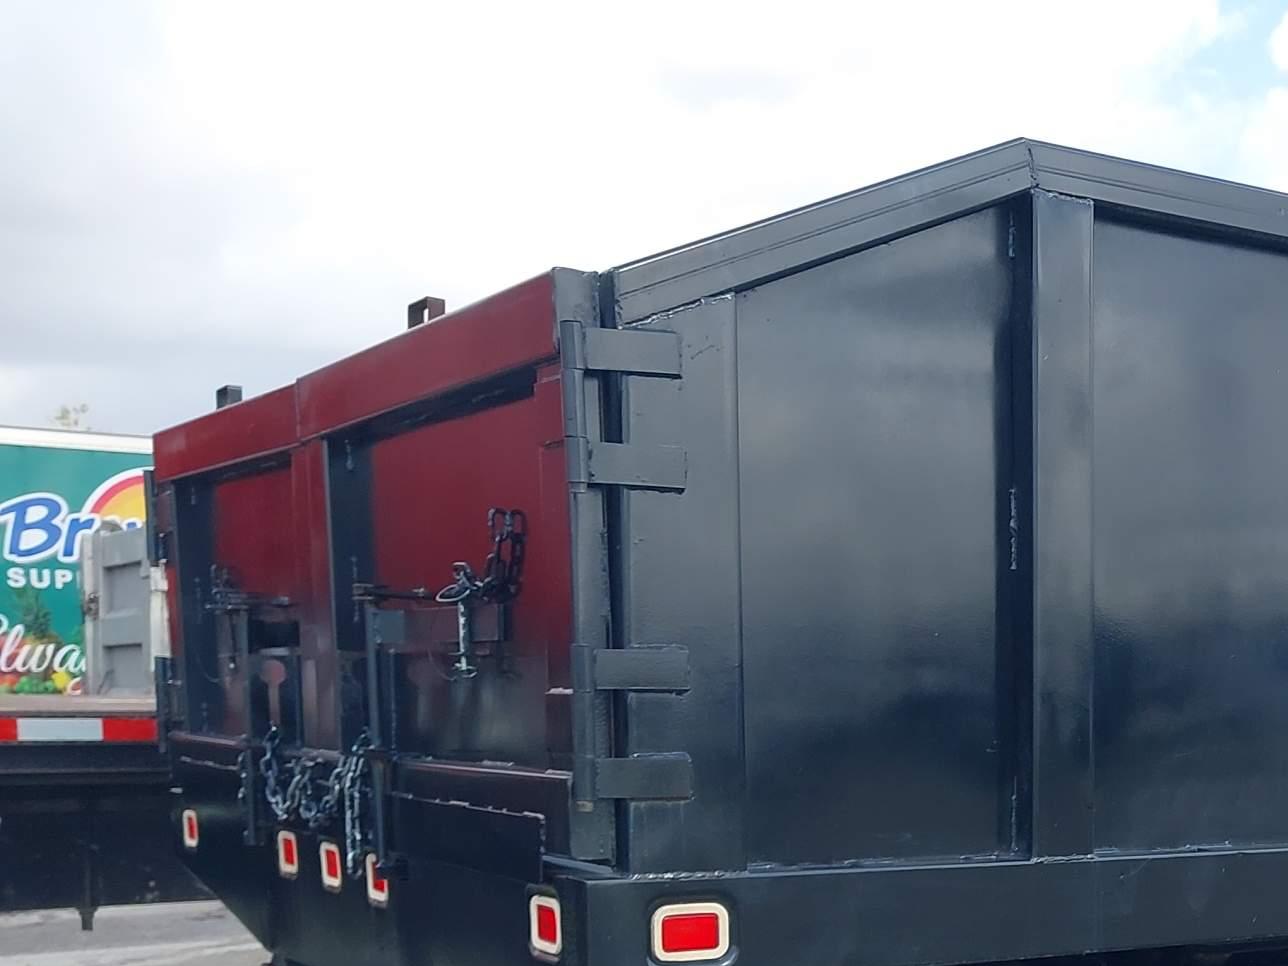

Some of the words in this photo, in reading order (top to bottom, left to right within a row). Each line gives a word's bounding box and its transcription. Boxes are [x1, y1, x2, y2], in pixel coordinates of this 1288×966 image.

[0, 497, 95, 557] Br
[6, 567, 79, 590] SUP
[0, 613, 86, 674] lwa
